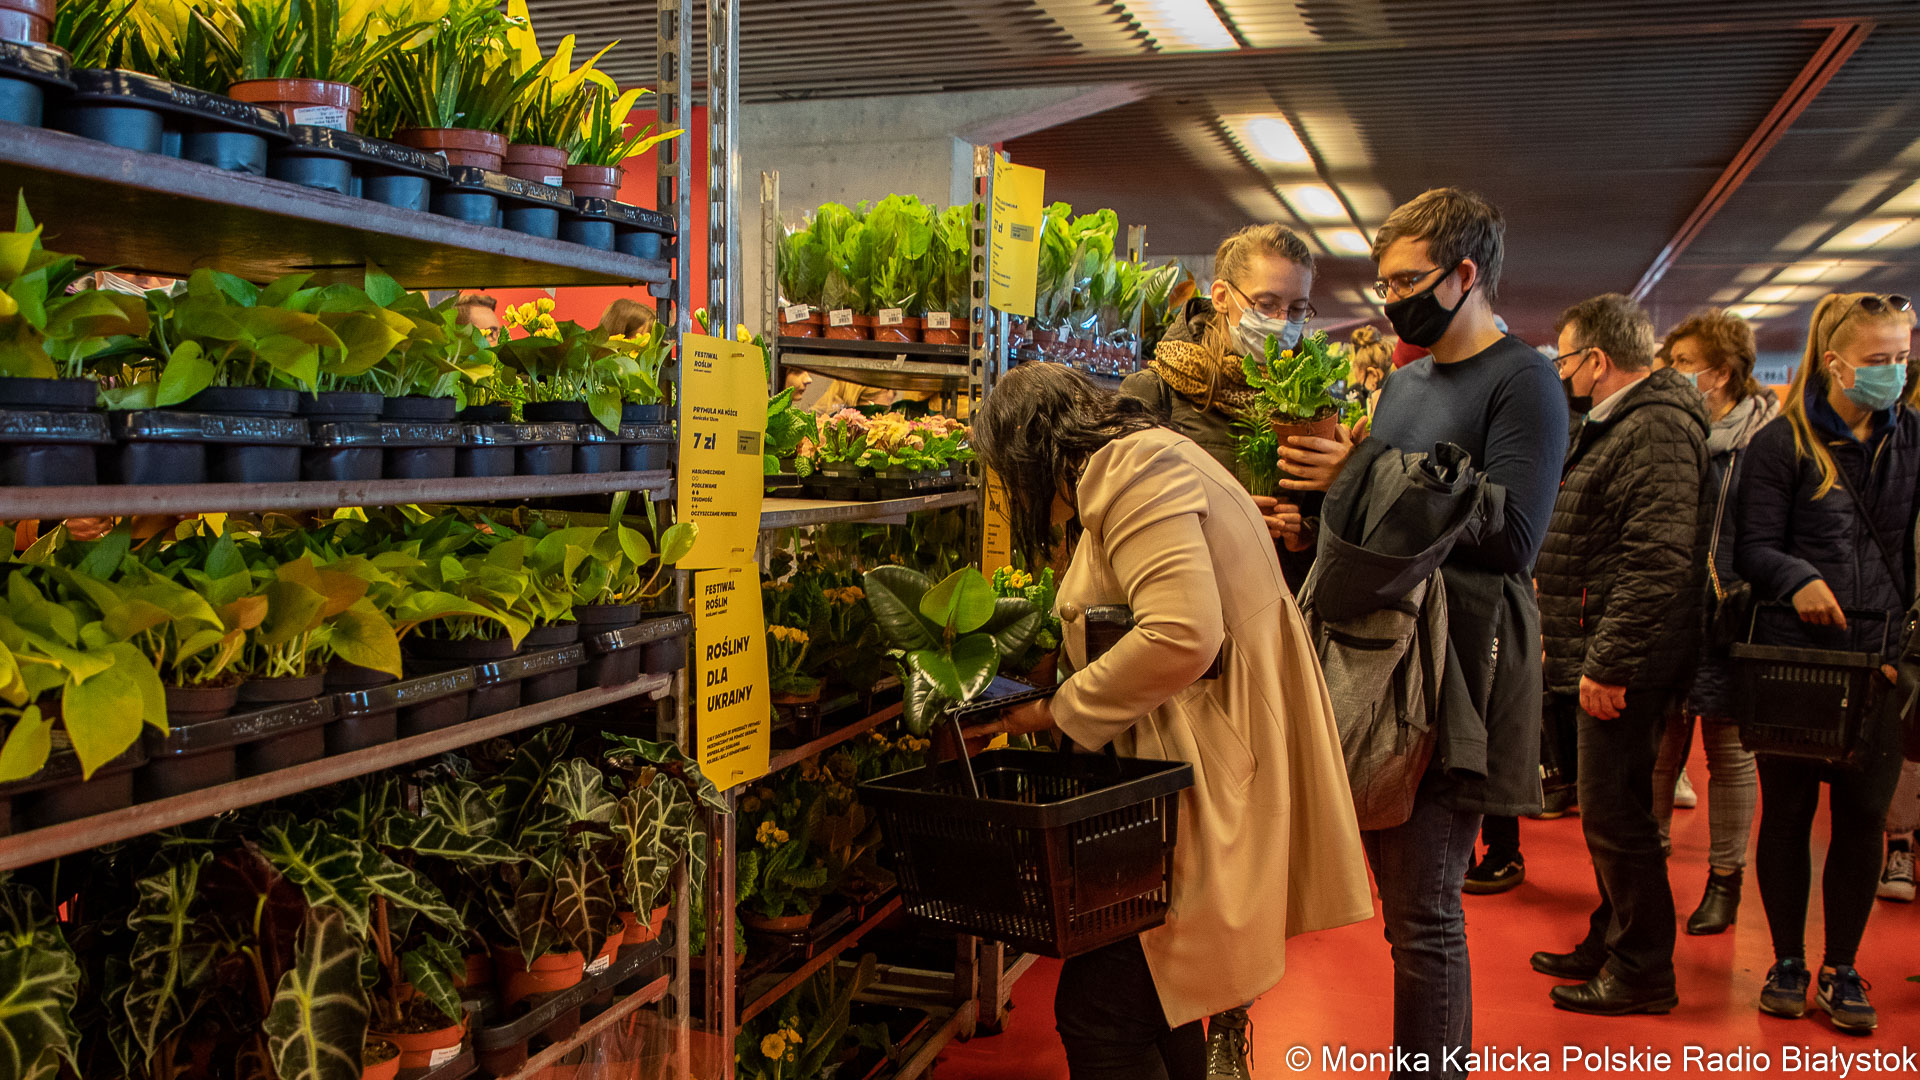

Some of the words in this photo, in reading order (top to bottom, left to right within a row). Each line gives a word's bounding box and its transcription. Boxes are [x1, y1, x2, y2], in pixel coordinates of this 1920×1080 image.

[694, 351, 718, 360] FESTIWAL
[694, 360, 712, 368] ROŚLIN
[693, 406, 717, 415] PRYMULA
[693, 432, 702, 449] 7
[704, 432, 716, 450] zł
[705, 581, 735, 595] FESTIWAL
[705, 595, 728, 610] ROŚLIN
[706, 635, 750, 661] ROŚLINY
[706, 666, 728, 687] DLA
[707, 684, 753, 712] UKRAINY
